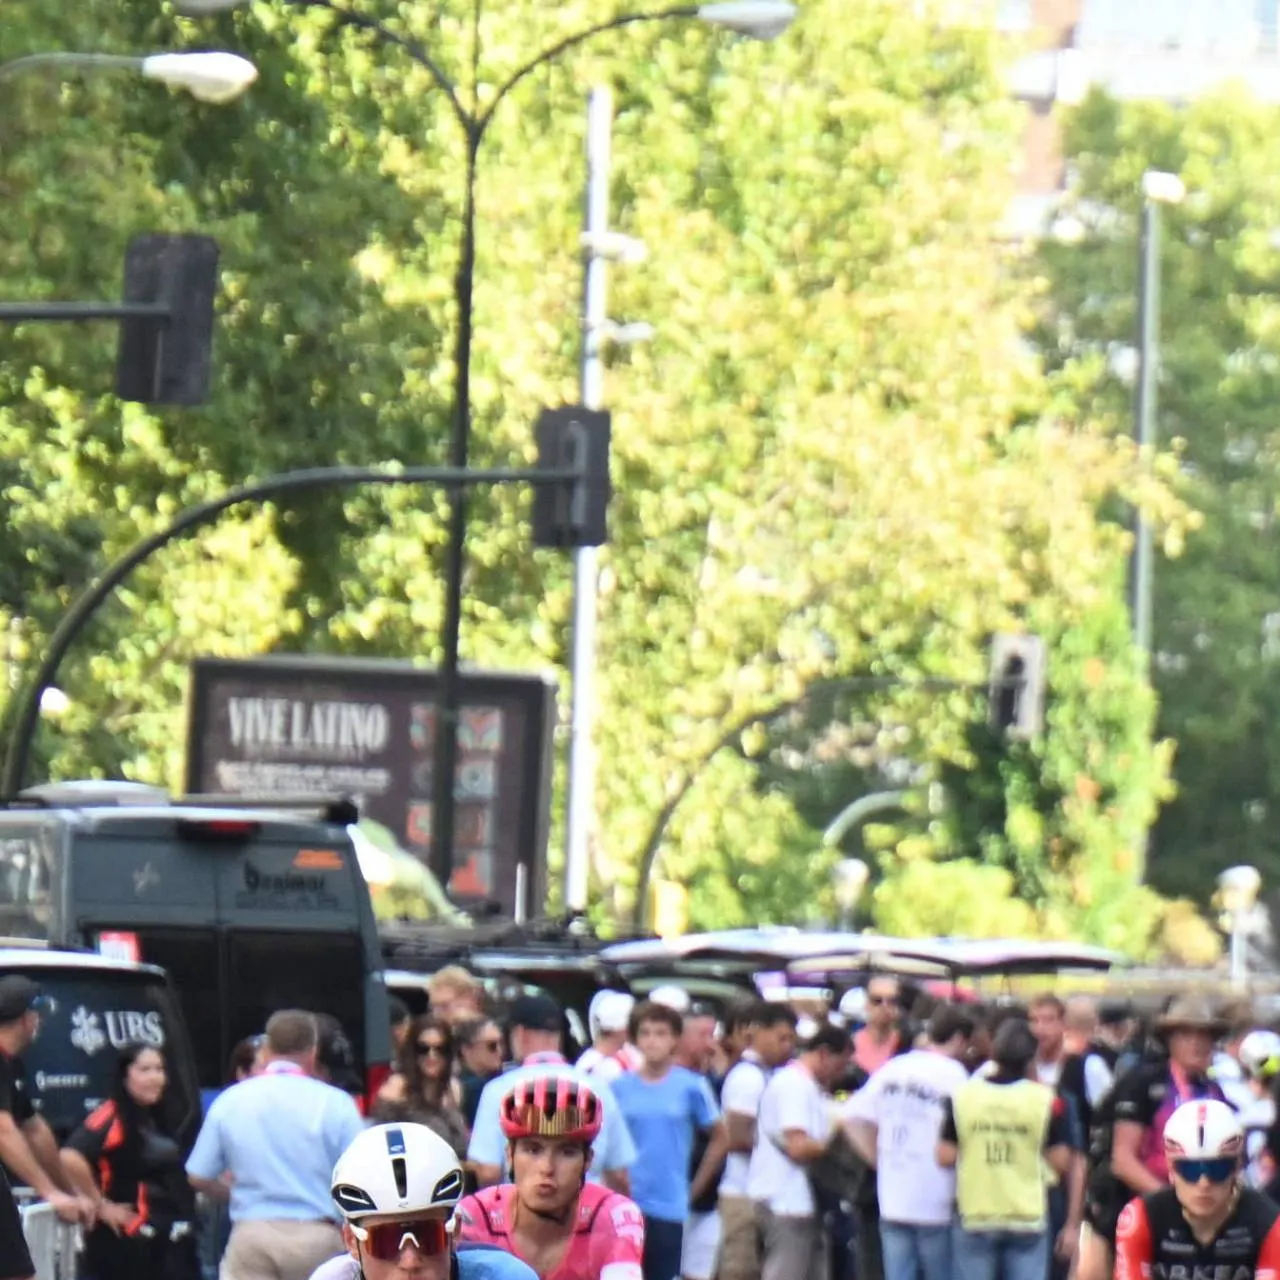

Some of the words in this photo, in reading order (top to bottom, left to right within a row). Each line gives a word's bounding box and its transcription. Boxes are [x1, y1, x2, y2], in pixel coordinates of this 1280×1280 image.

[228, 696, 288, 747] VIVE
[291, 700, 389, 753] LATINO
[103, 1010, 165, 1050] UBS
